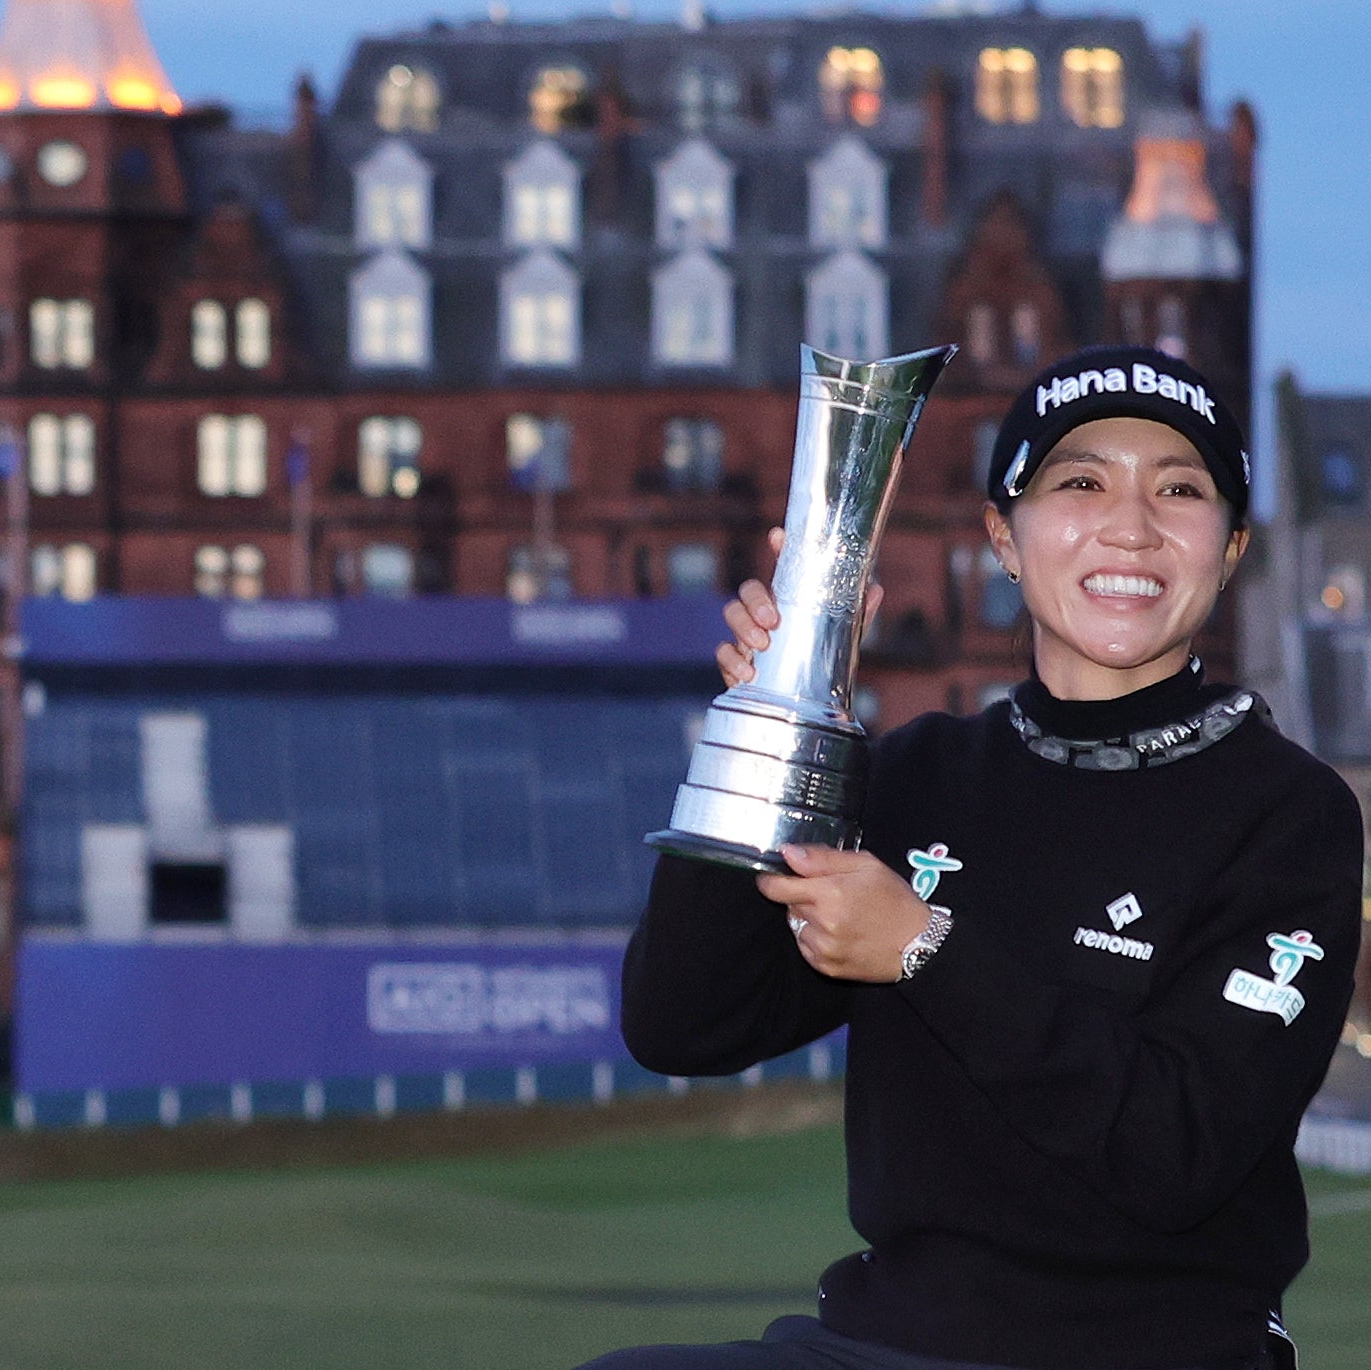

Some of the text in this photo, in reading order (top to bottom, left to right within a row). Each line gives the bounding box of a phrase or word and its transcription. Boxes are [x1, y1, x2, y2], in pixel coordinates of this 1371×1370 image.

[1036, 363, 1216, 425] Hana Bank
[1073, 926, 1154, 961] renoma
[1234, 977, 1302, 1020] 하나카드
